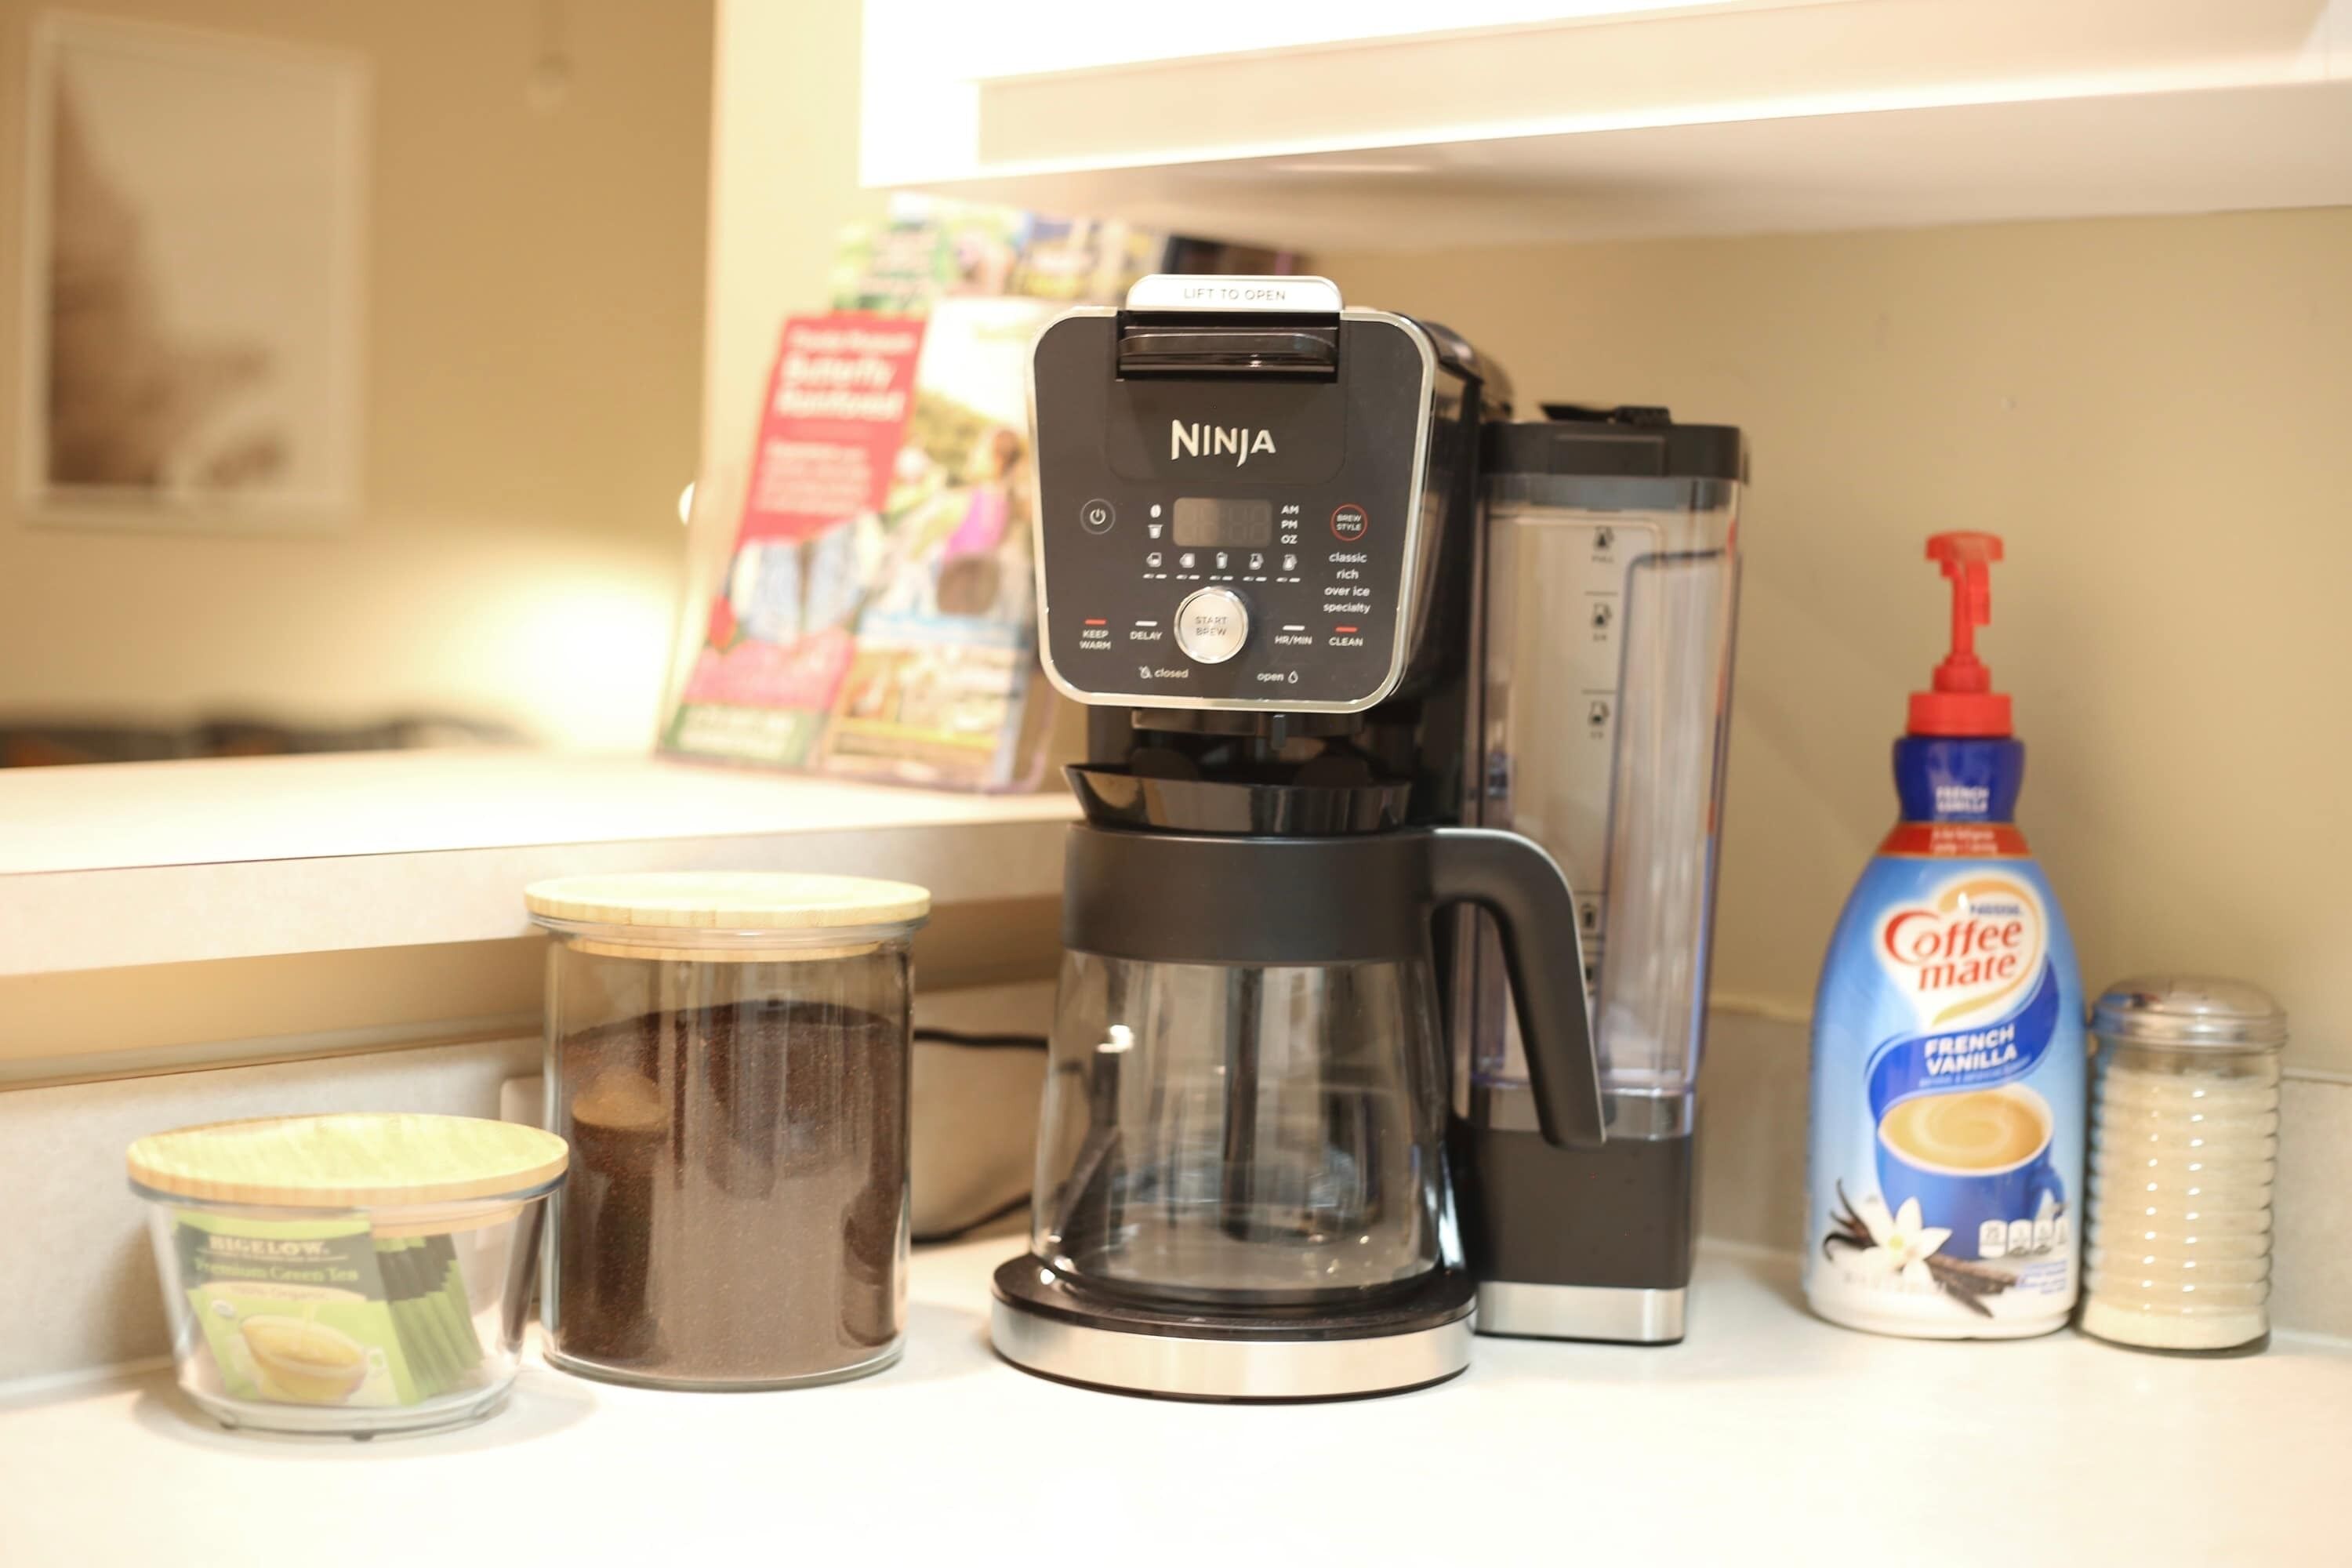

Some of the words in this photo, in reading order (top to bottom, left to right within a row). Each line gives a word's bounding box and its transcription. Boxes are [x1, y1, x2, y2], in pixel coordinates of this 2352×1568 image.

[1183, 288, 1214, 299] LIFT
[1221, 289, 1240, 300] TO
[1244, 289, 1286, 301] OPEN
[1170, 419, 1276, 467] NINJA
[1280, 504, 1300, 515] AM
[1336, 514, 1362, 523] BREW
[1280, 519, 1298, 530] PM
[1335, 523, 1363, 532] STYLE
[1280, 534, 1298, 545] OZ
[1328, 551, 1368, 563] classic
[1336, 568, 1359, 580] rich
[1323, 586, 1351, 597] over
[1352, 586, 1370, 597] ice
[1323, 602, 1371, 615] specialty
[1194, 615, 1229, 626] START
[1082, 630, 1109, 639] KEEP
[1129, 630, 1163, 641] DELAY
[1195, 626, 1228, 637] BREW
[1079, 641, 1112, 650] WARM
[1274, 635, 1313, 645] HR/MIN
[1328, 636, 1364, 647] CLEAN
[1154, 668, 1189, 678] closed
[1256, 672, 1285, 683] open
[1884, 909, 2023, 967] Coffee
[1918, 954, 2016, 992] mate
[1924, 1022, 2016, 1058] FRENCH
[1926, 1043, 2018, 1076] VANILLA
